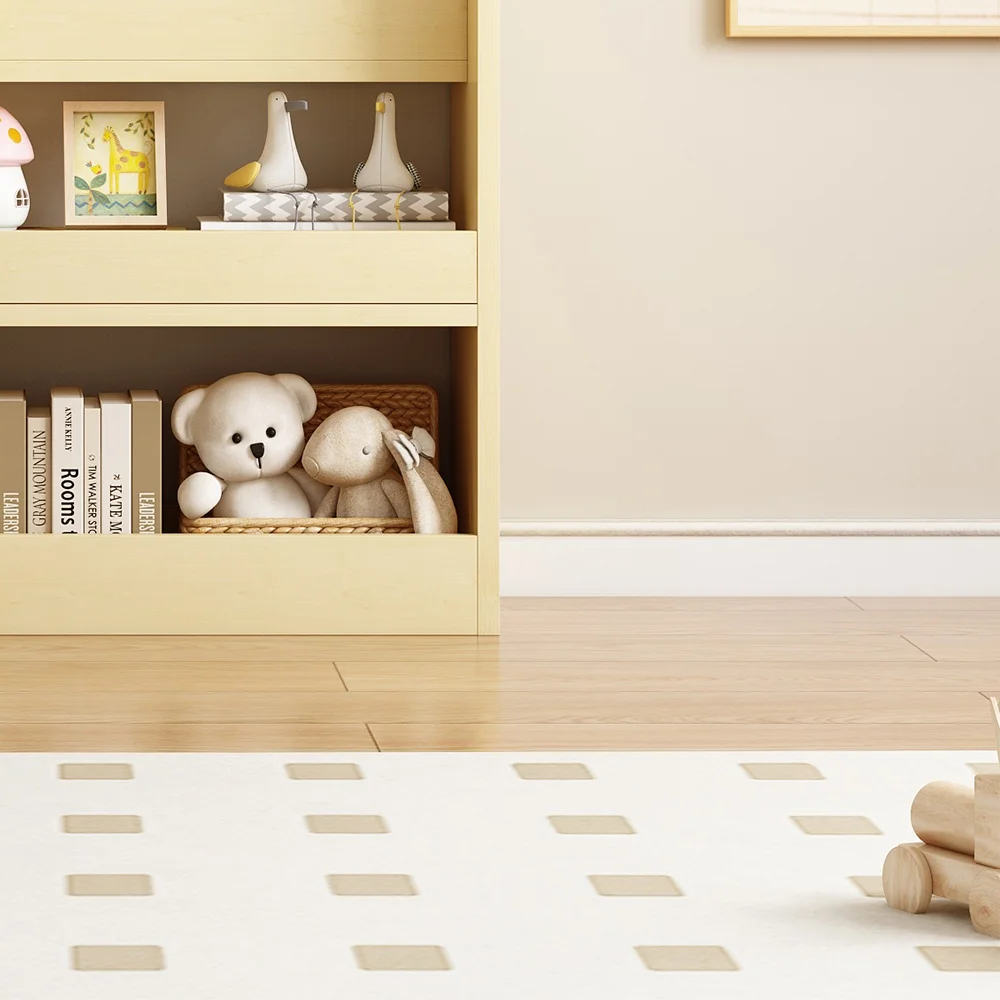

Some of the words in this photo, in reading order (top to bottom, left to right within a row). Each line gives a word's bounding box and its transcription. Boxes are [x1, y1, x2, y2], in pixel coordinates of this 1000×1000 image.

[32, 430, 47, 495] MOUNTAIN
[88, 465, 97, 480] TIM
[32, 496, 47, 527] GRAY
[61, 468, 79, 526] Rooms
[88, 482, 97, 518] WALKER
[110, 484, 123, 518] KATE
[110, 521, 123, 534] M
